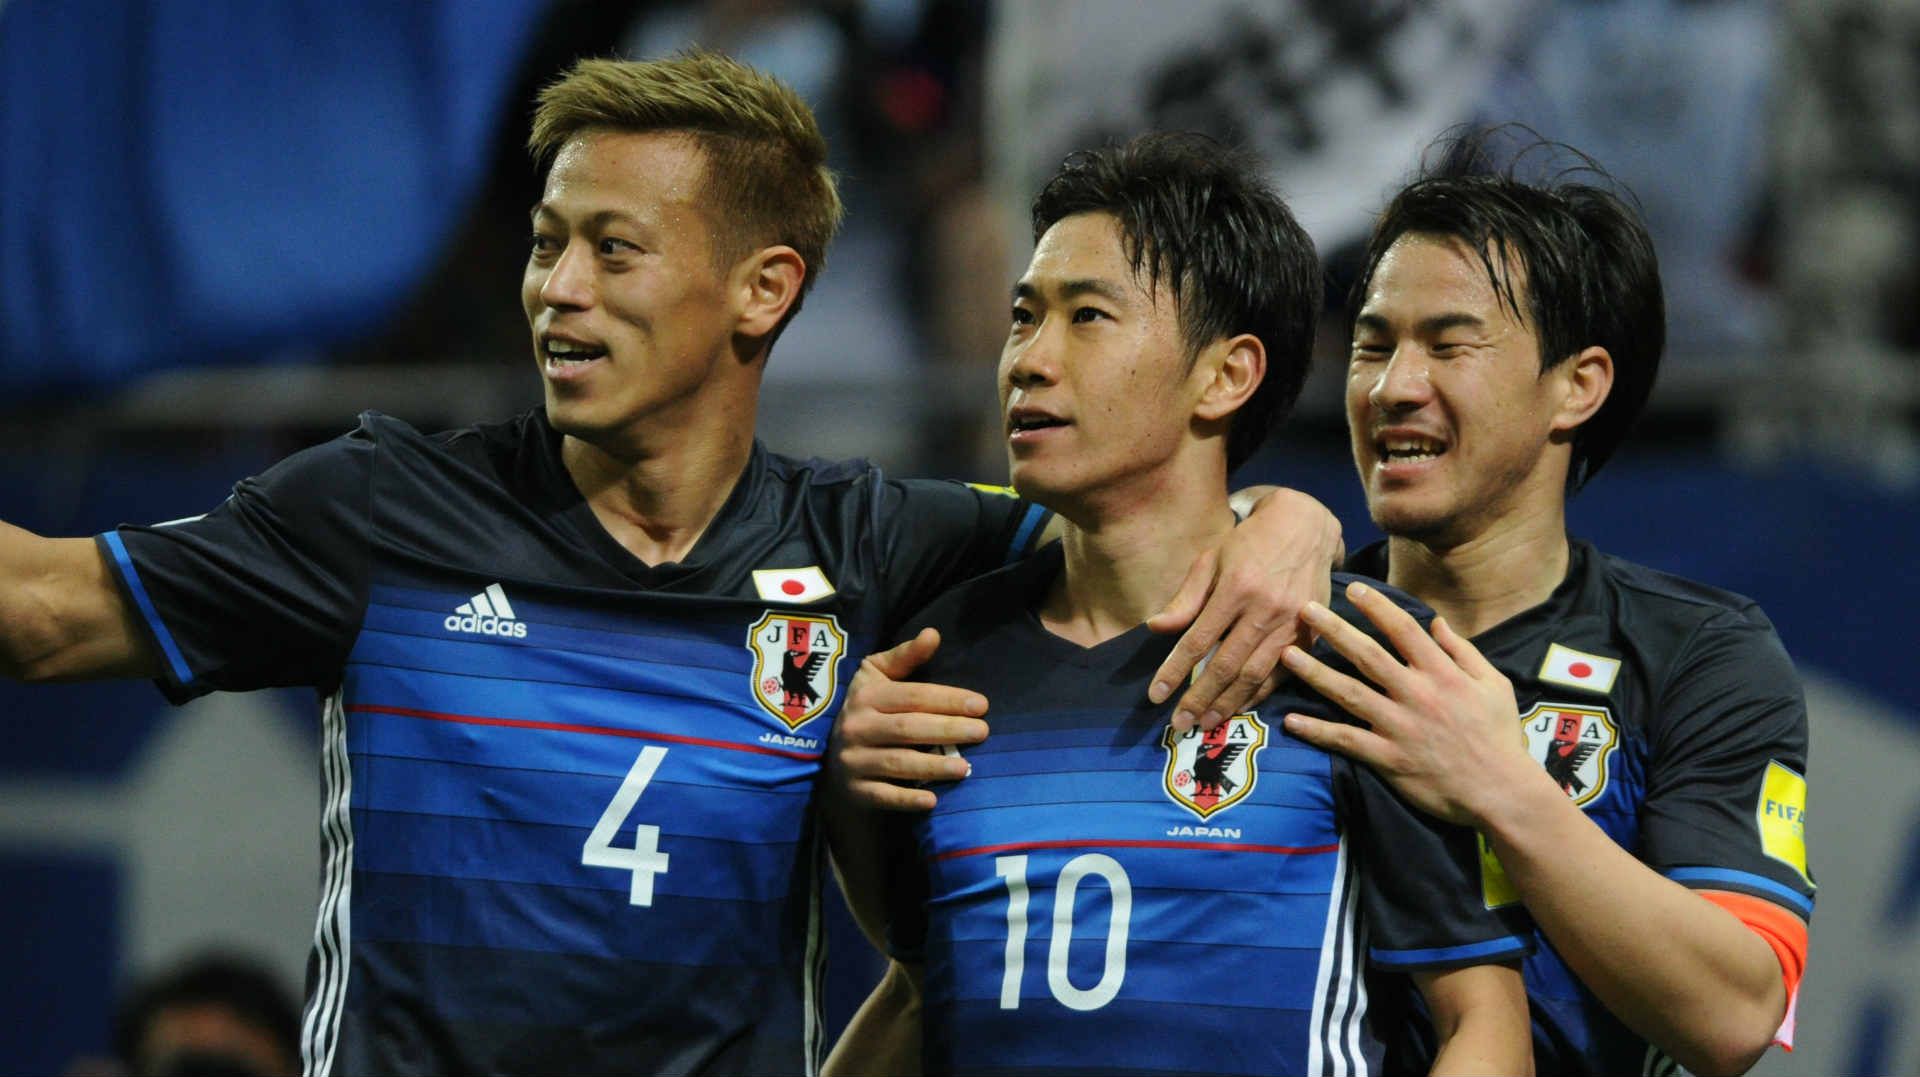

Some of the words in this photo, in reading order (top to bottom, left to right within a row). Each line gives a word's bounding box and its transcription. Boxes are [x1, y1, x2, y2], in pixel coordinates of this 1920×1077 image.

[444, 613, 527, 638] adidas
[759, 732, 818, 749] JAPAN
[582, 746, 669, 907] 4
[1166, 827, 1241, 839] JAPAN
[995, 853, 1132, 1011] 10
